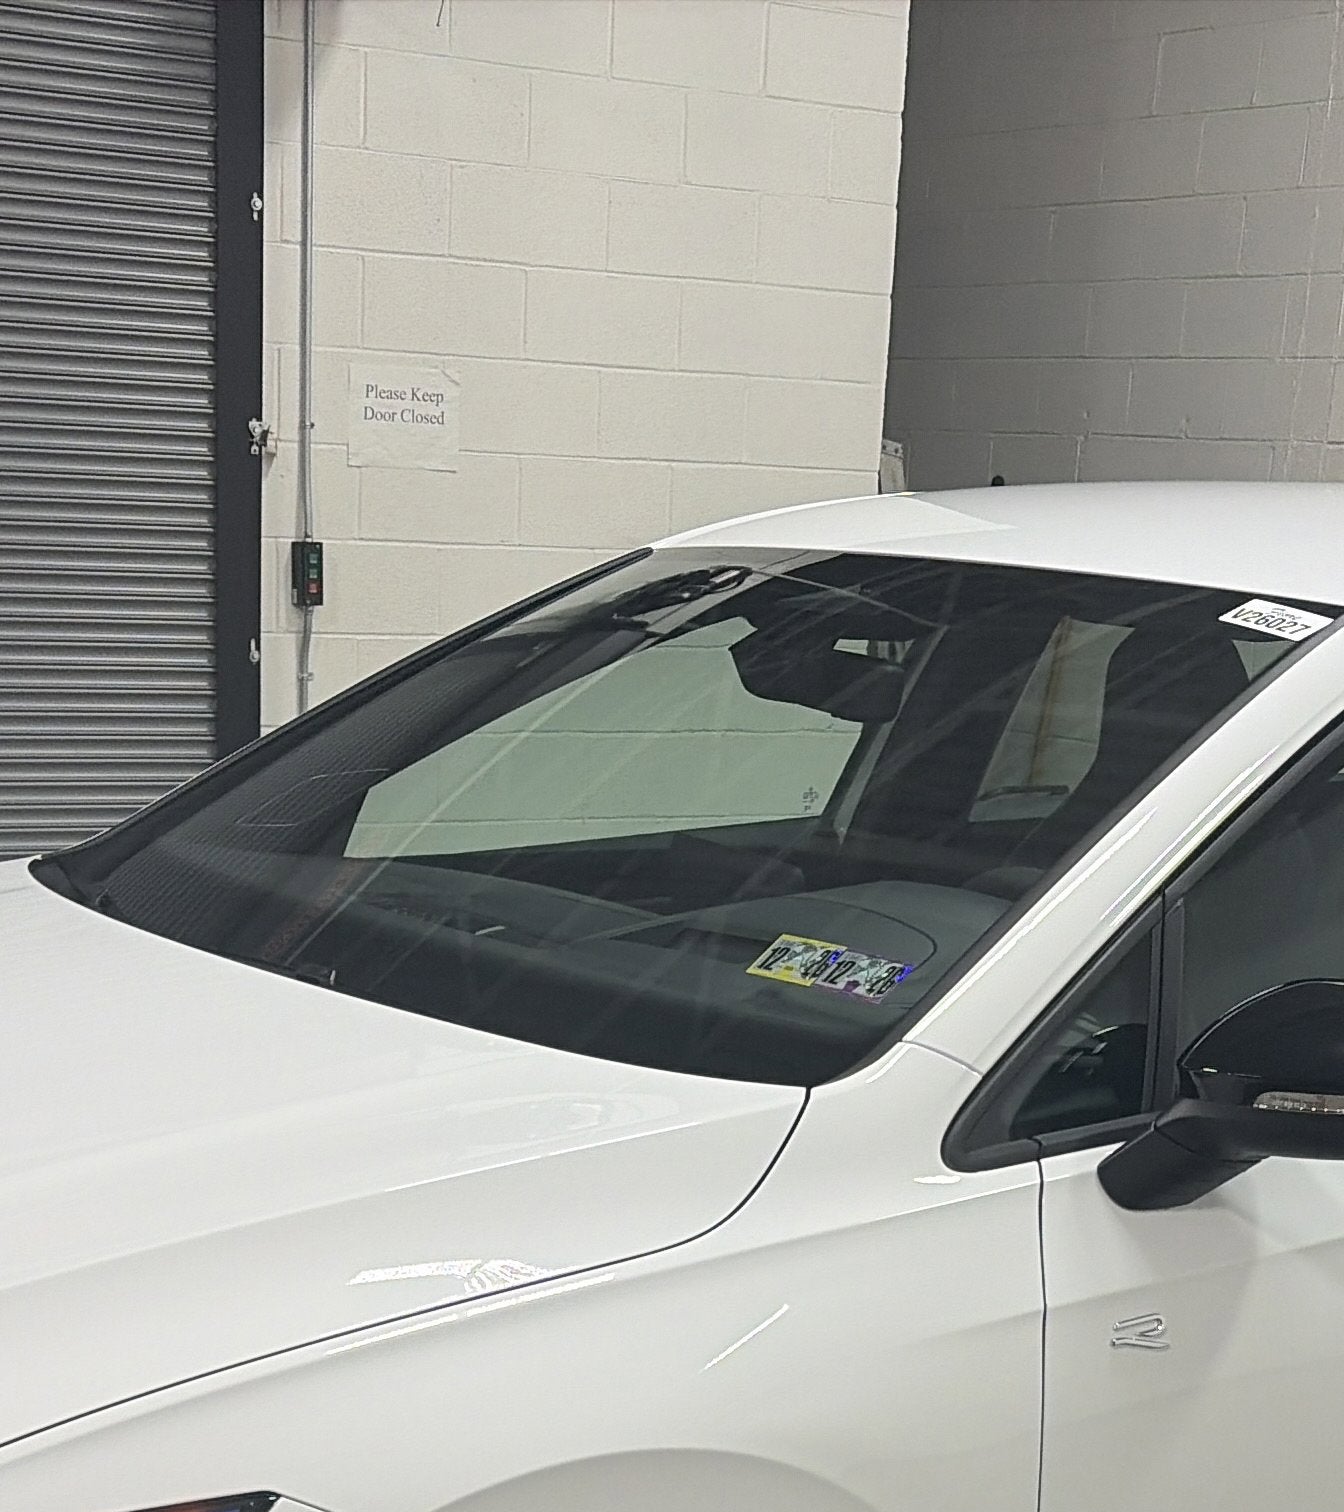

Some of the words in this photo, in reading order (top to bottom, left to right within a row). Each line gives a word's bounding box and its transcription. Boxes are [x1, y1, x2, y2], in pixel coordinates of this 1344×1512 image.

[365, 384, 407, 401] Please
[411, 387, 444, 407] Keep
[364, 406, 397, 422] Door
[400, 408, 445, 425] Closed
[1231, 607, 1311, 634] V26027
[757, 946, 791, 971] 12
[822, 960, 856, 985] 12
